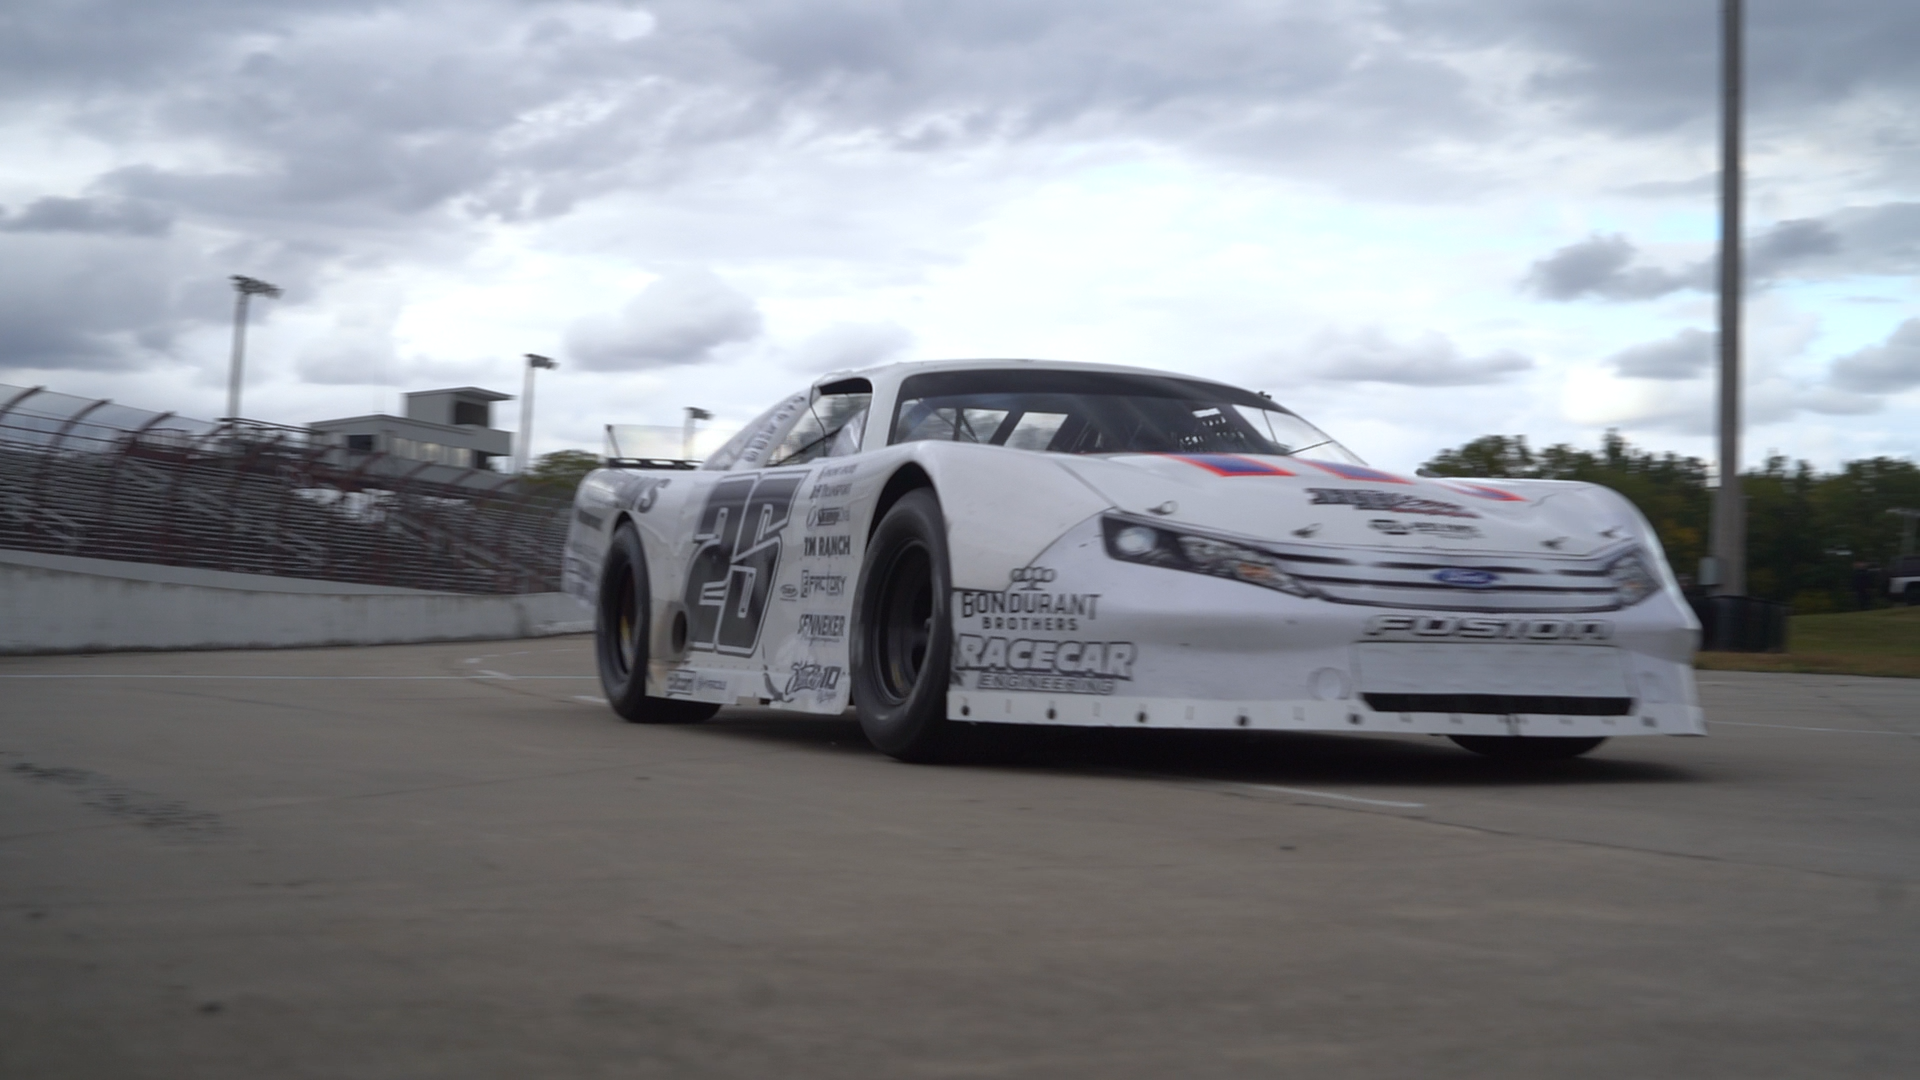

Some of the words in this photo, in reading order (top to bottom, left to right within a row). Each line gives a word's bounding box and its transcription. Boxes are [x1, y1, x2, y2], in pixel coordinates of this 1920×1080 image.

[819, 534, 851, 556] RANCH
[962, 592, 1102, 620] BONDURANT
[982, 616, 1078, 631] BROTHERS
[1361, 614, 1615, 641] FUSION
[954, 632, 1137, 681] RACECAR
[979, 673, 1116, 695] ENGINEERING
